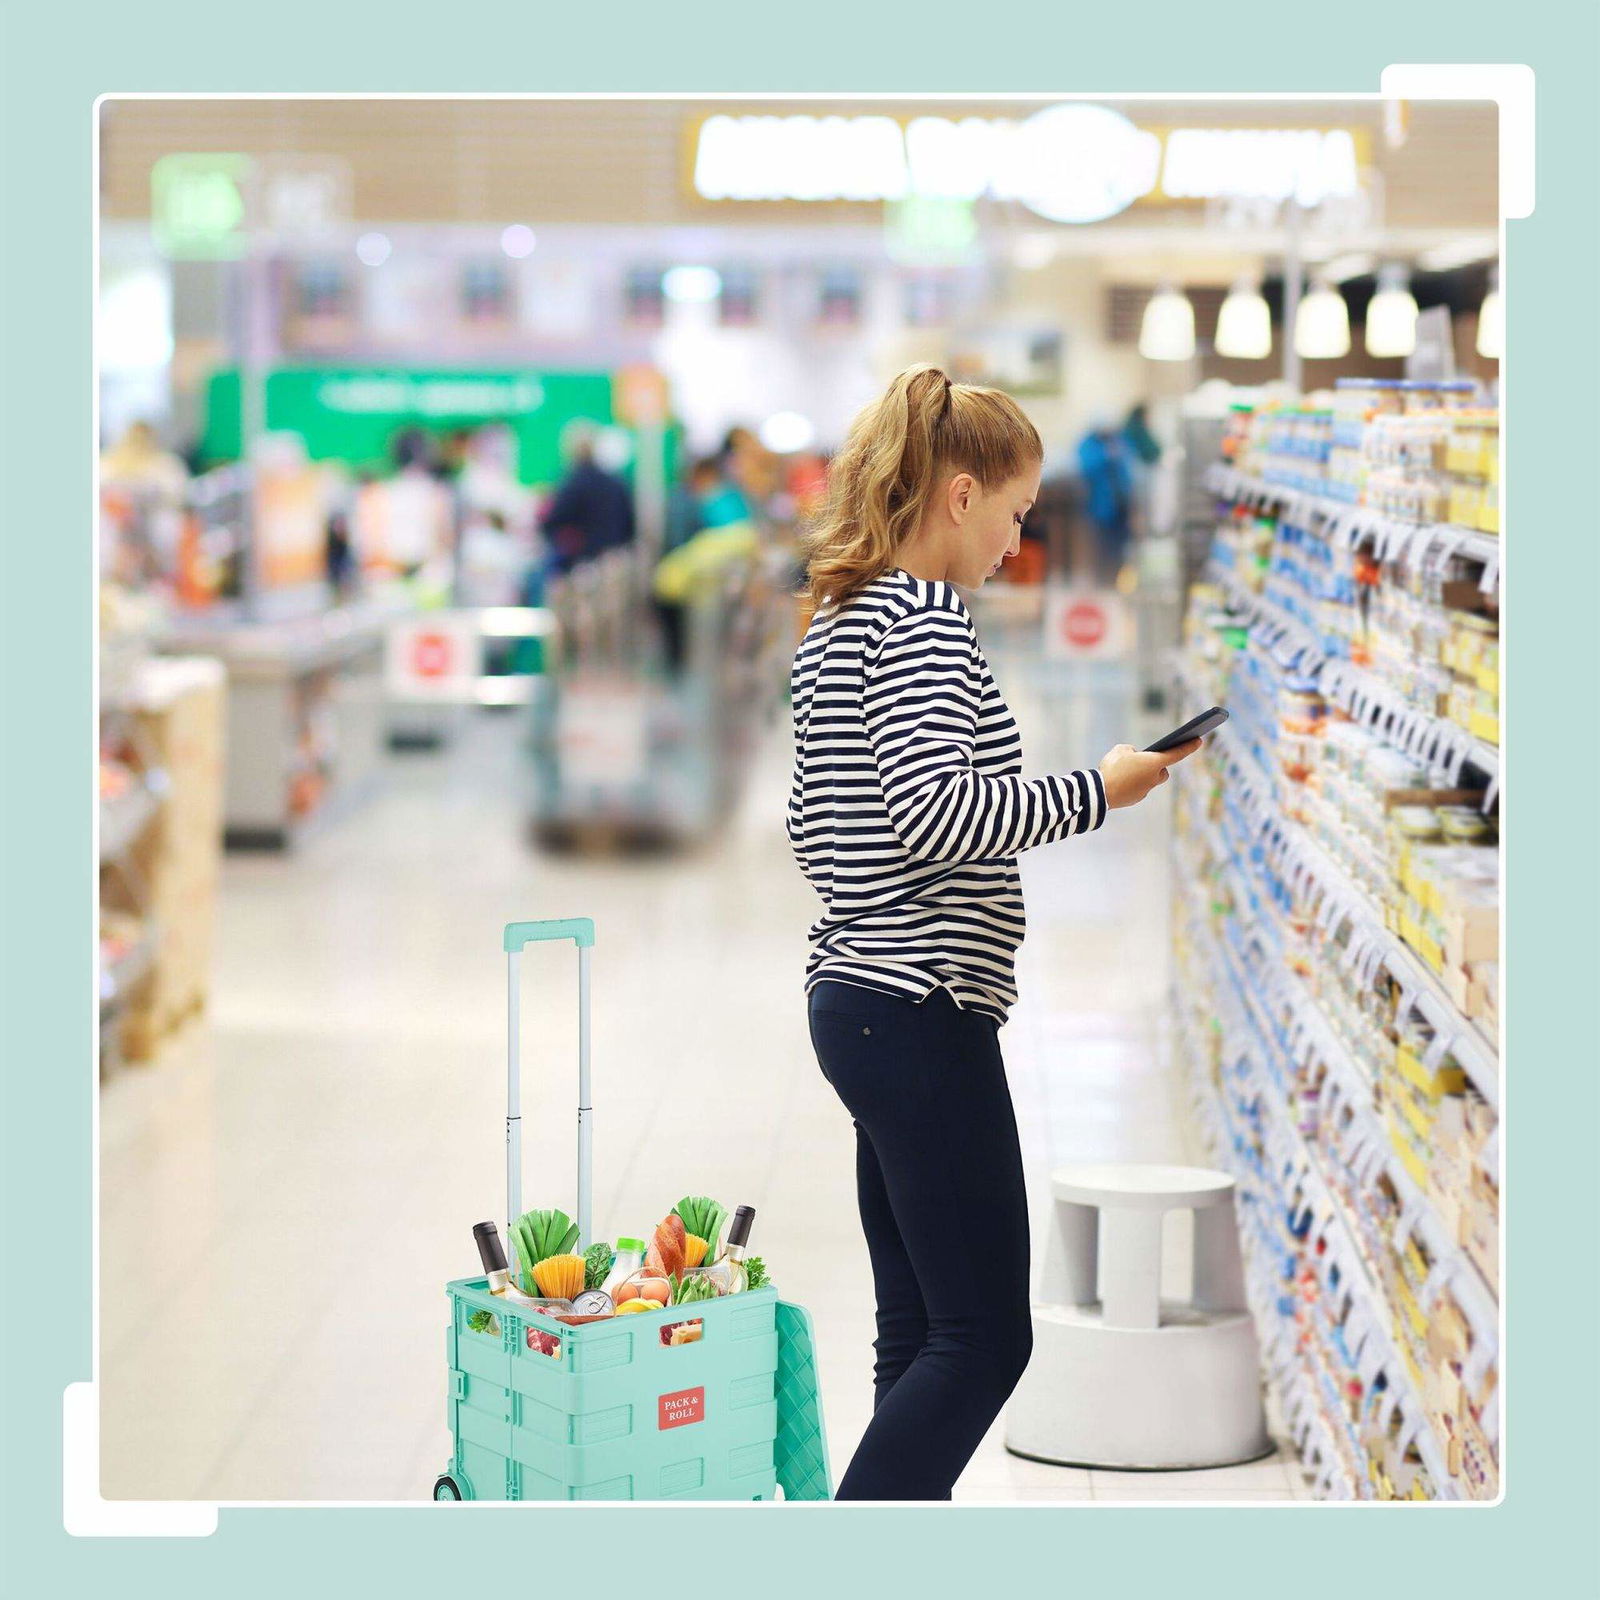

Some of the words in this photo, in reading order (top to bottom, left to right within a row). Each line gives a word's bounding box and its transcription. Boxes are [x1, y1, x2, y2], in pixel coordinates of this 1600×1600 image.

[664, 1396, 690, 1411] PACK
[691, 1396, 699, 1405] &
[669, 1407, 696, 1421] ROLL
